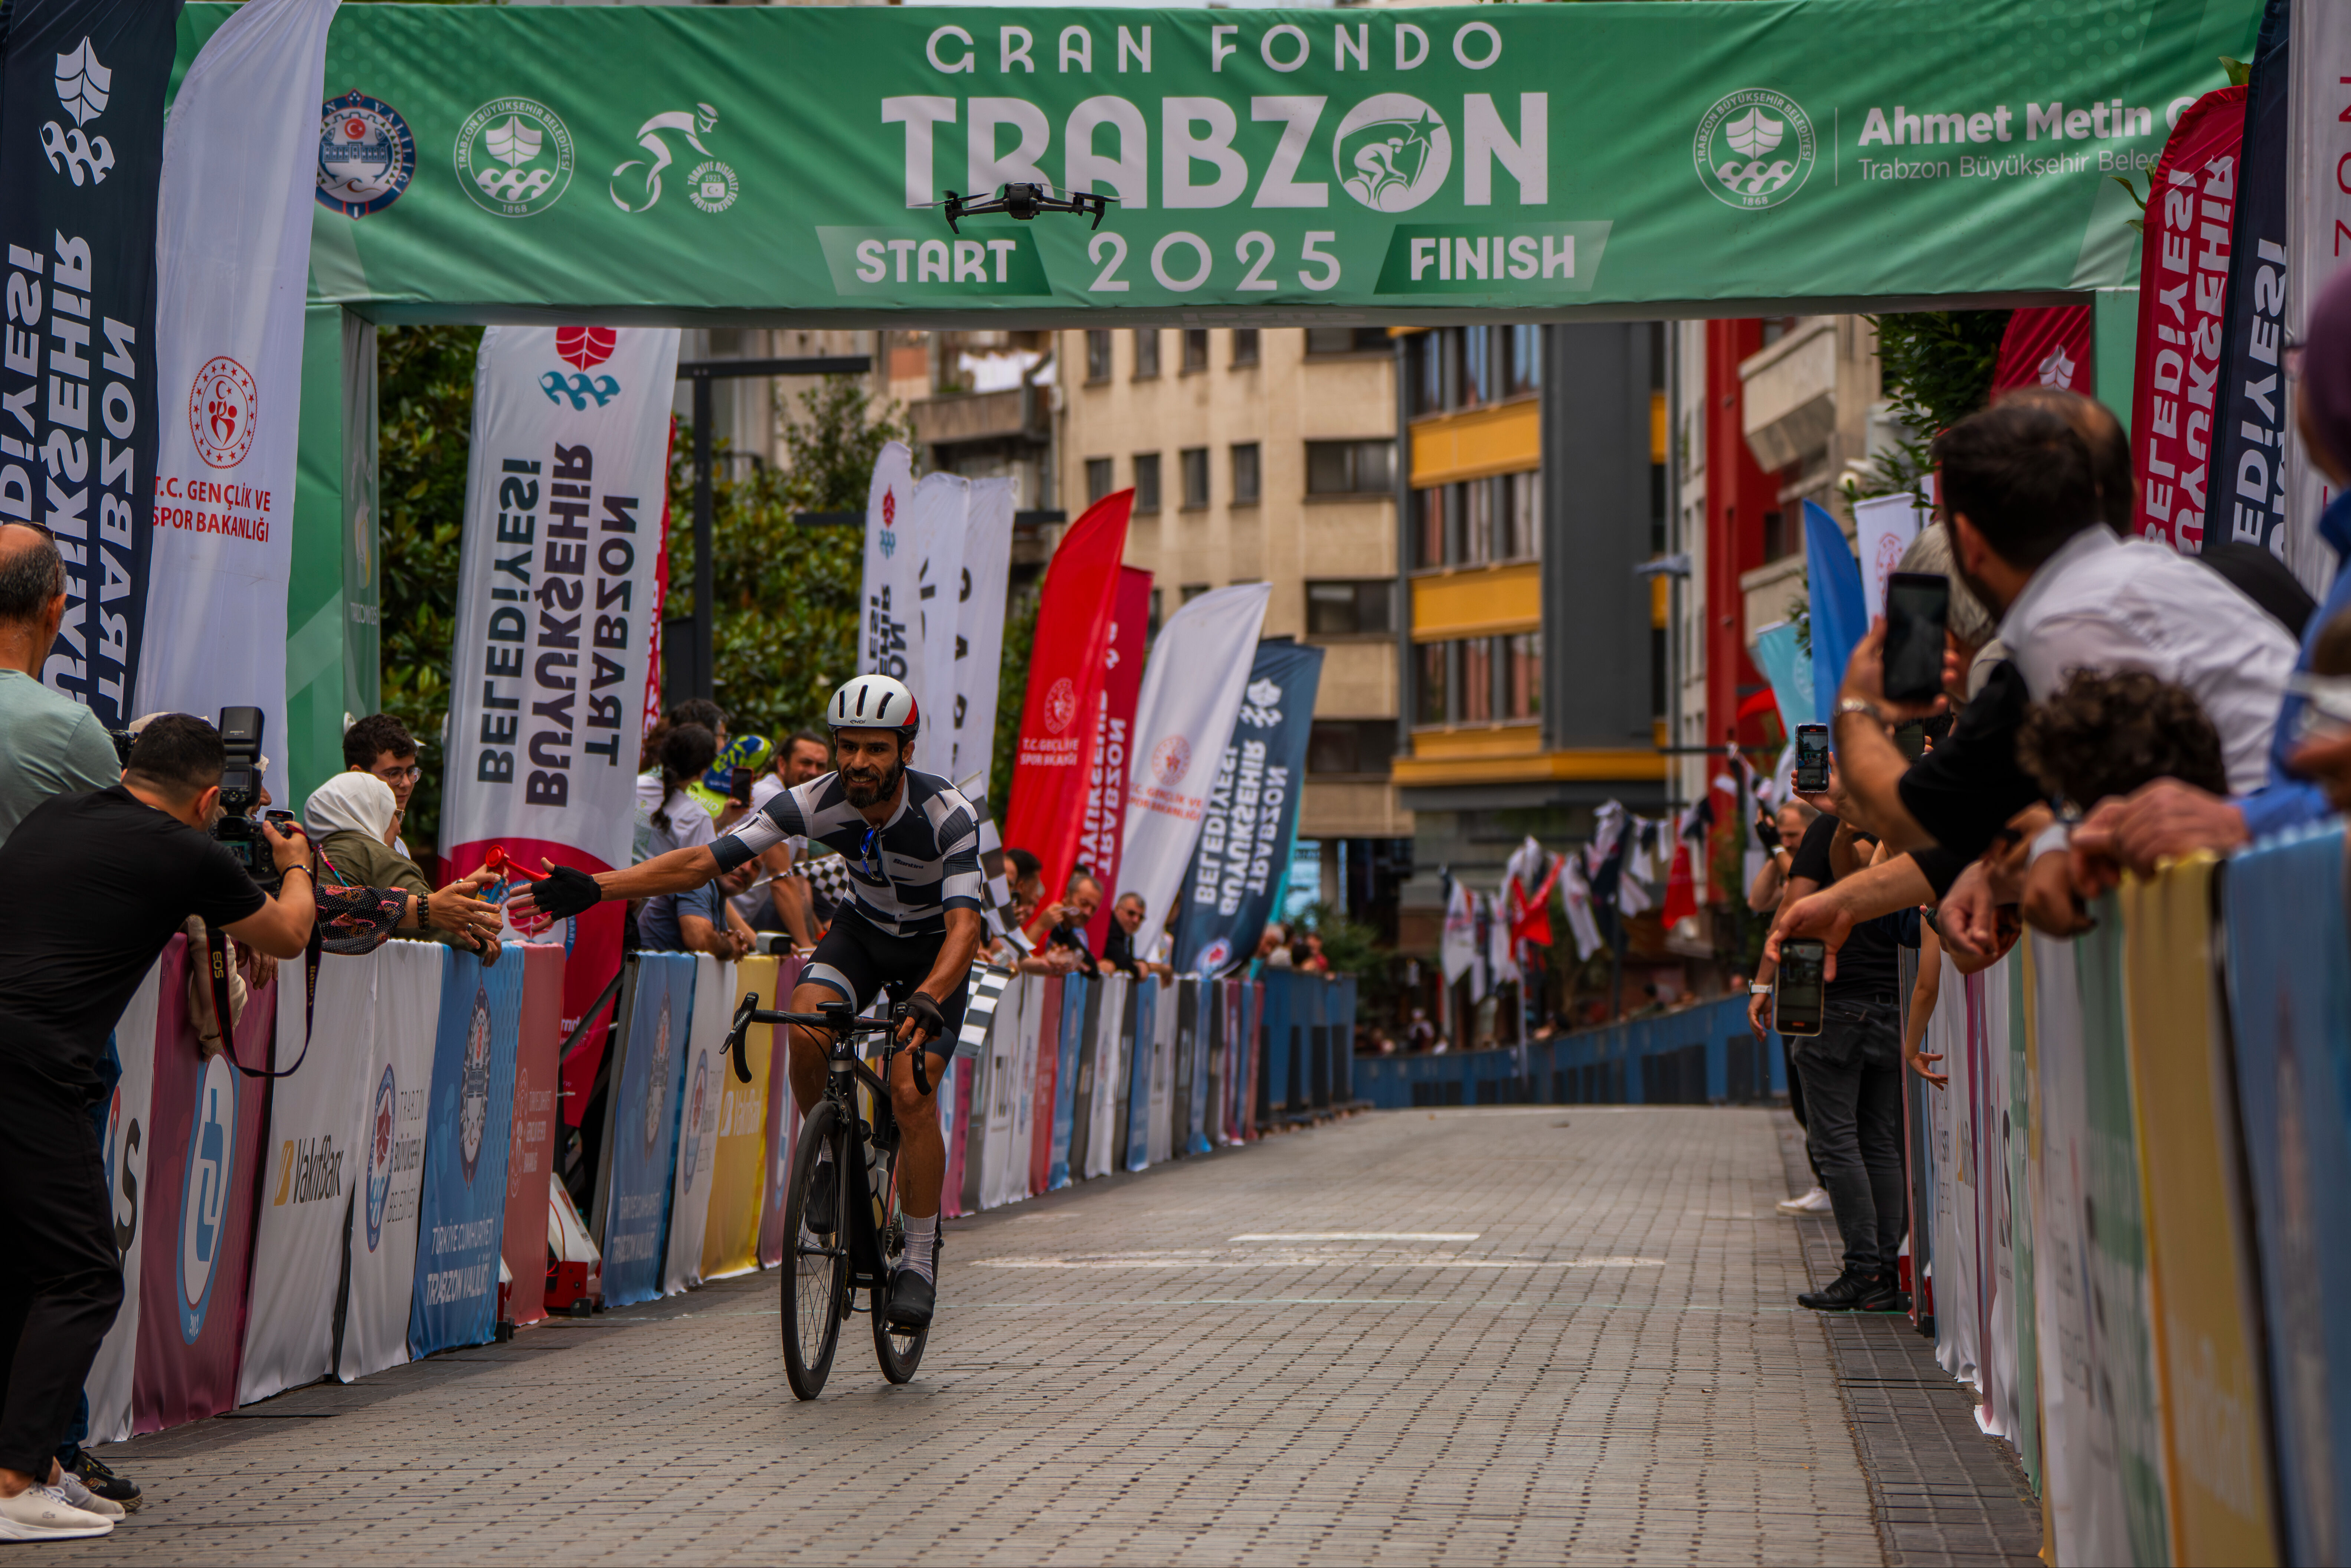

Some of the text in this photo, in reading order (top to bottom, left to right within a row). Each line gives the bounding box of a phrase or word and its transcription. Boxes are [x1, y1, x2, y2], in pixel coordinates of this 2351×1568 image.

[927, 22, 1503, 73] GRAN FONDO
[458, 101, 571, 172] TRABZON BÜYÜKŞEHİR BELEDİYESİ
[1697, 92, 1812, 164] TRABZON BÜYÜKŞEHİR BELEDİYESİ
[1858, 105, 2012, 146] Ahmet
[2026, 99, 2152, 141] Metin
[881, 91, 1549, 214] TRABZON
[1858, 157, 1950, 180] Trabzon
[1960, 151, 2090, 180] Büyükşehir
[502, 204, 527, 214] 1868
[1742, 196, 1768, 206] 1868
[856, 231, 1575, 292] START 2025 FINISH
[187, 480, 252, 511] GENÇLİK
[255, 489, 271, 512] VE
[153, 506, 269, 543] SPOR BAKANLIĞI
[893, 858, 924, 869] Santini
[212, 951, 223, 979] EOS
[399, 1088, 425, 1123] TRABZON
[426, 1269, 464, 1306] TRABZON
[189, 1313, 199, 1338] 2012
